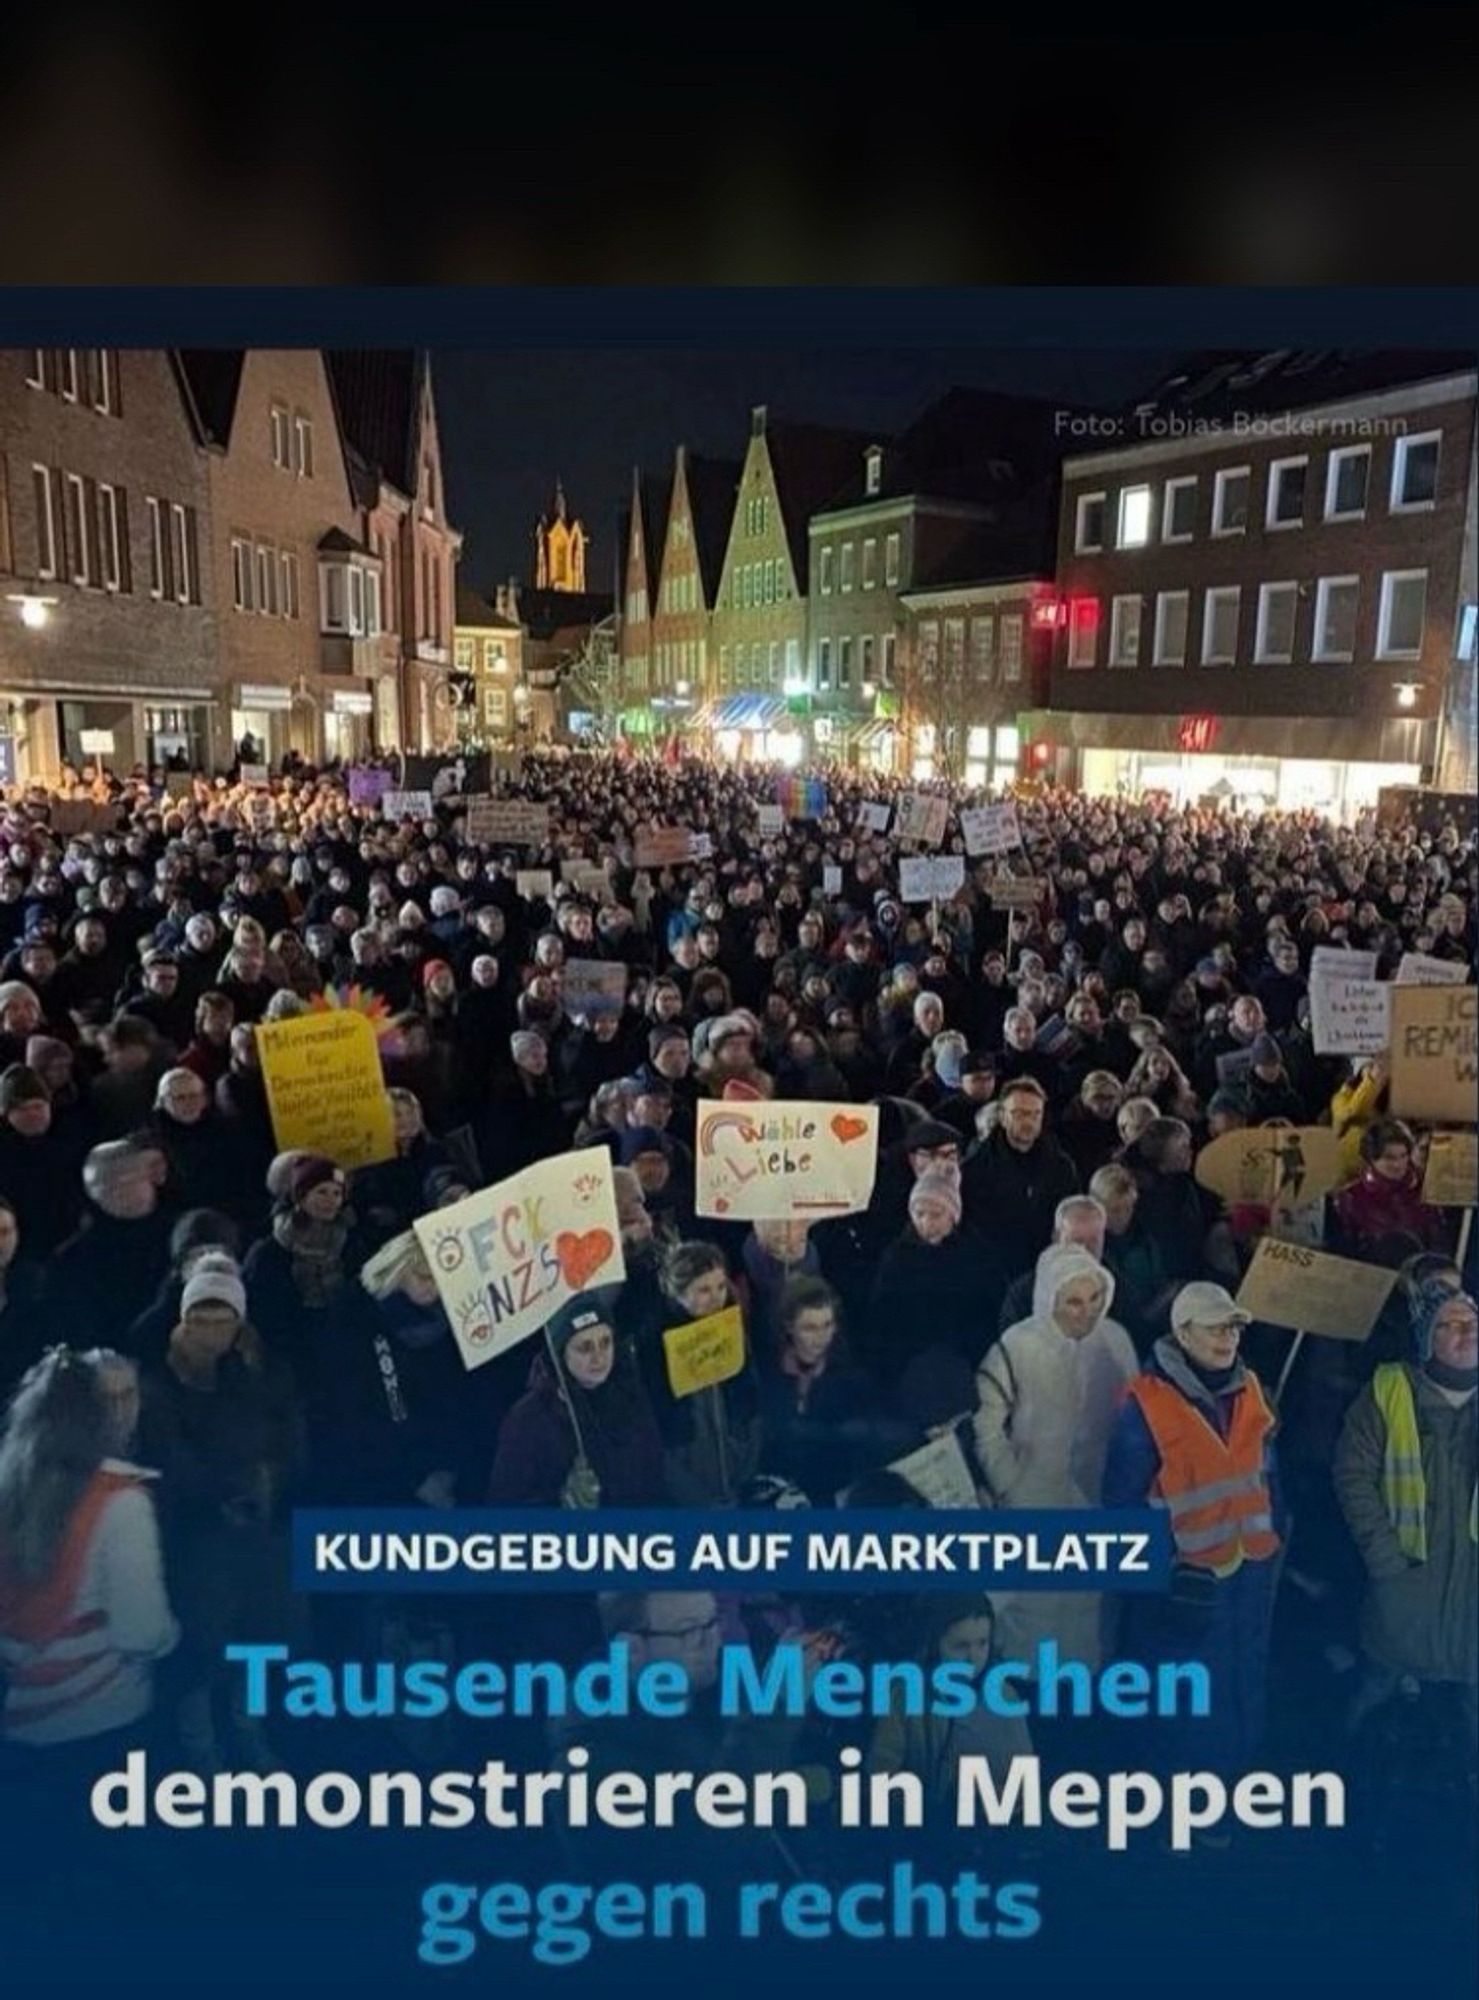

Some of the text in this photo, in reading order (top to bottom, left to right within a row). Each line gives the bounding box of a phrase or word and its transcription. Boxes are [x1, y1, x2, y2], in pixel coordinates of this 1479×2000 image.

[724, 1148, 812, 1183] Liebe
[1263, 1241, 1315, 1269] HASS
[487, 1243, 561, 1324] NZS
